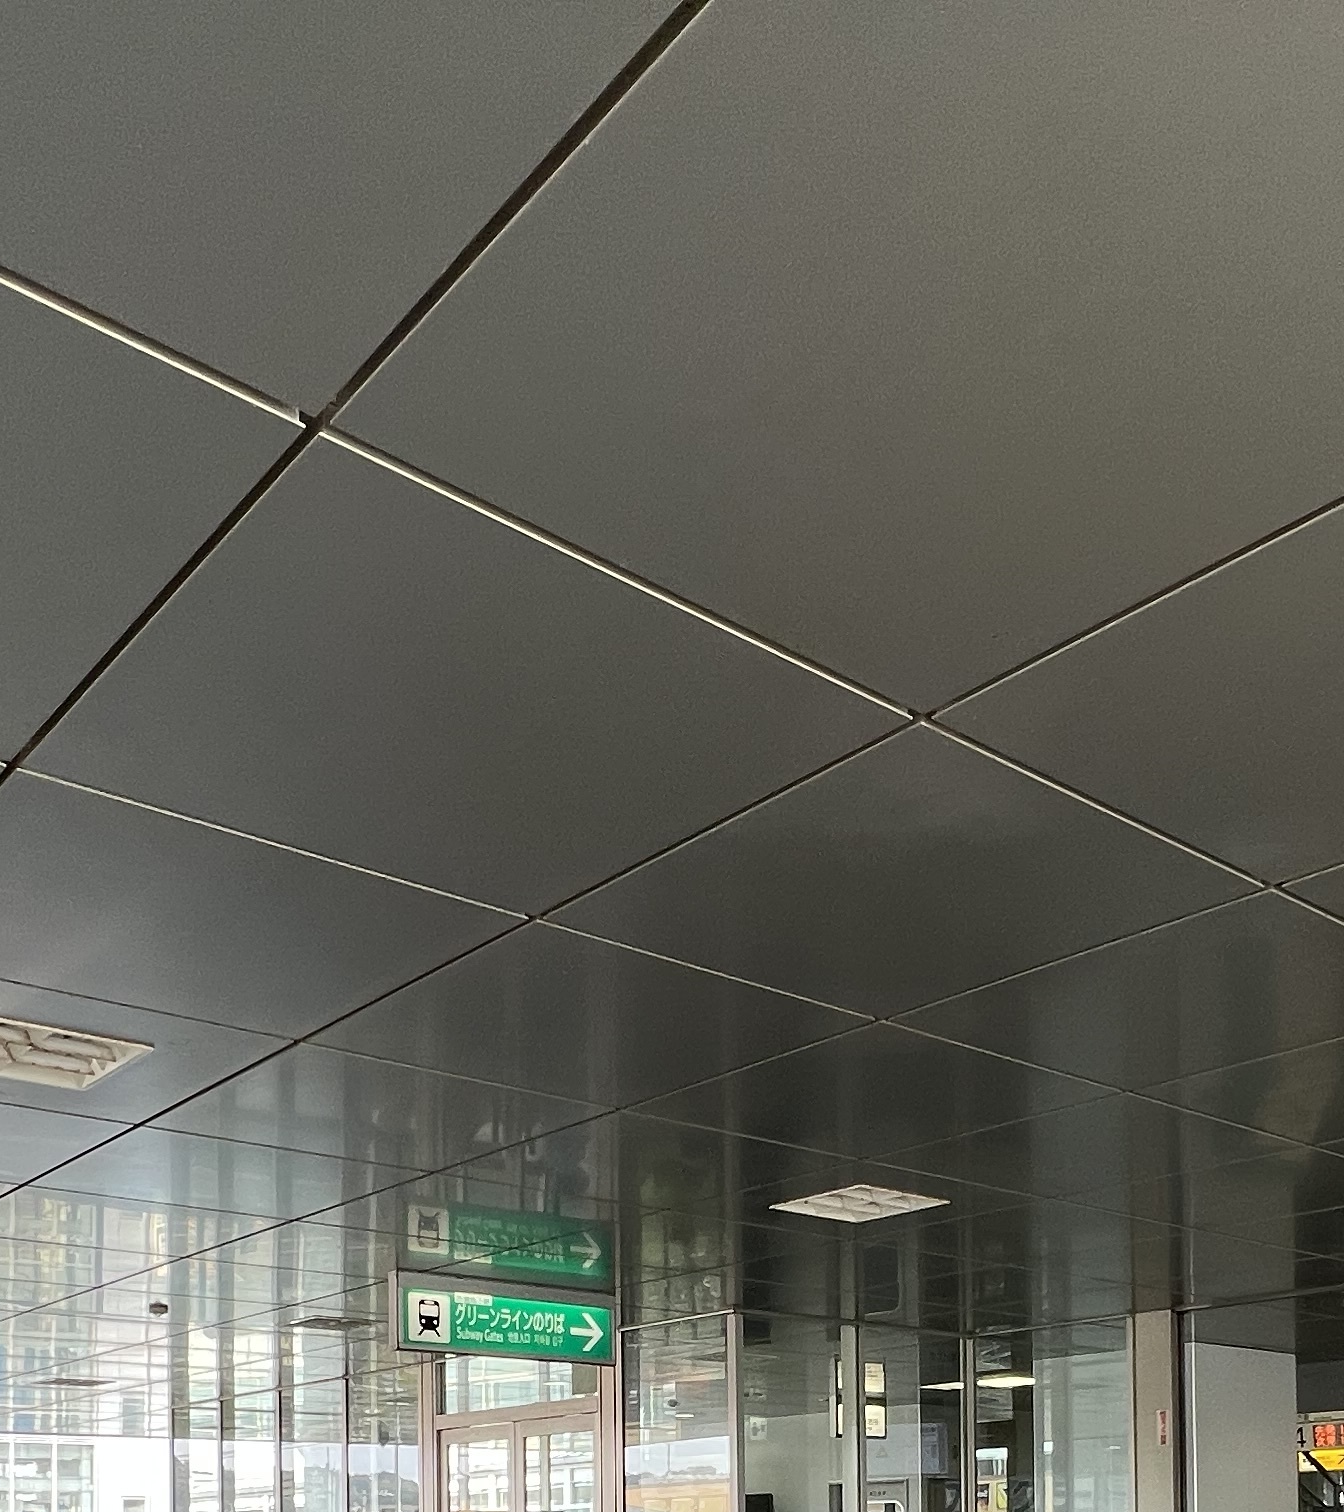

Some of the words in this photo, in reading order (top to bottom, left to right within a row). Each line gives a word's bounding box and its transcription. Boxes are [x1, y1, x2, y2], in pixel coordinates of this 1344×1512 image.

[455, 1303, 565, 1334] グリーンラインのりば
[457, 1326, 483, 1343] Subway
